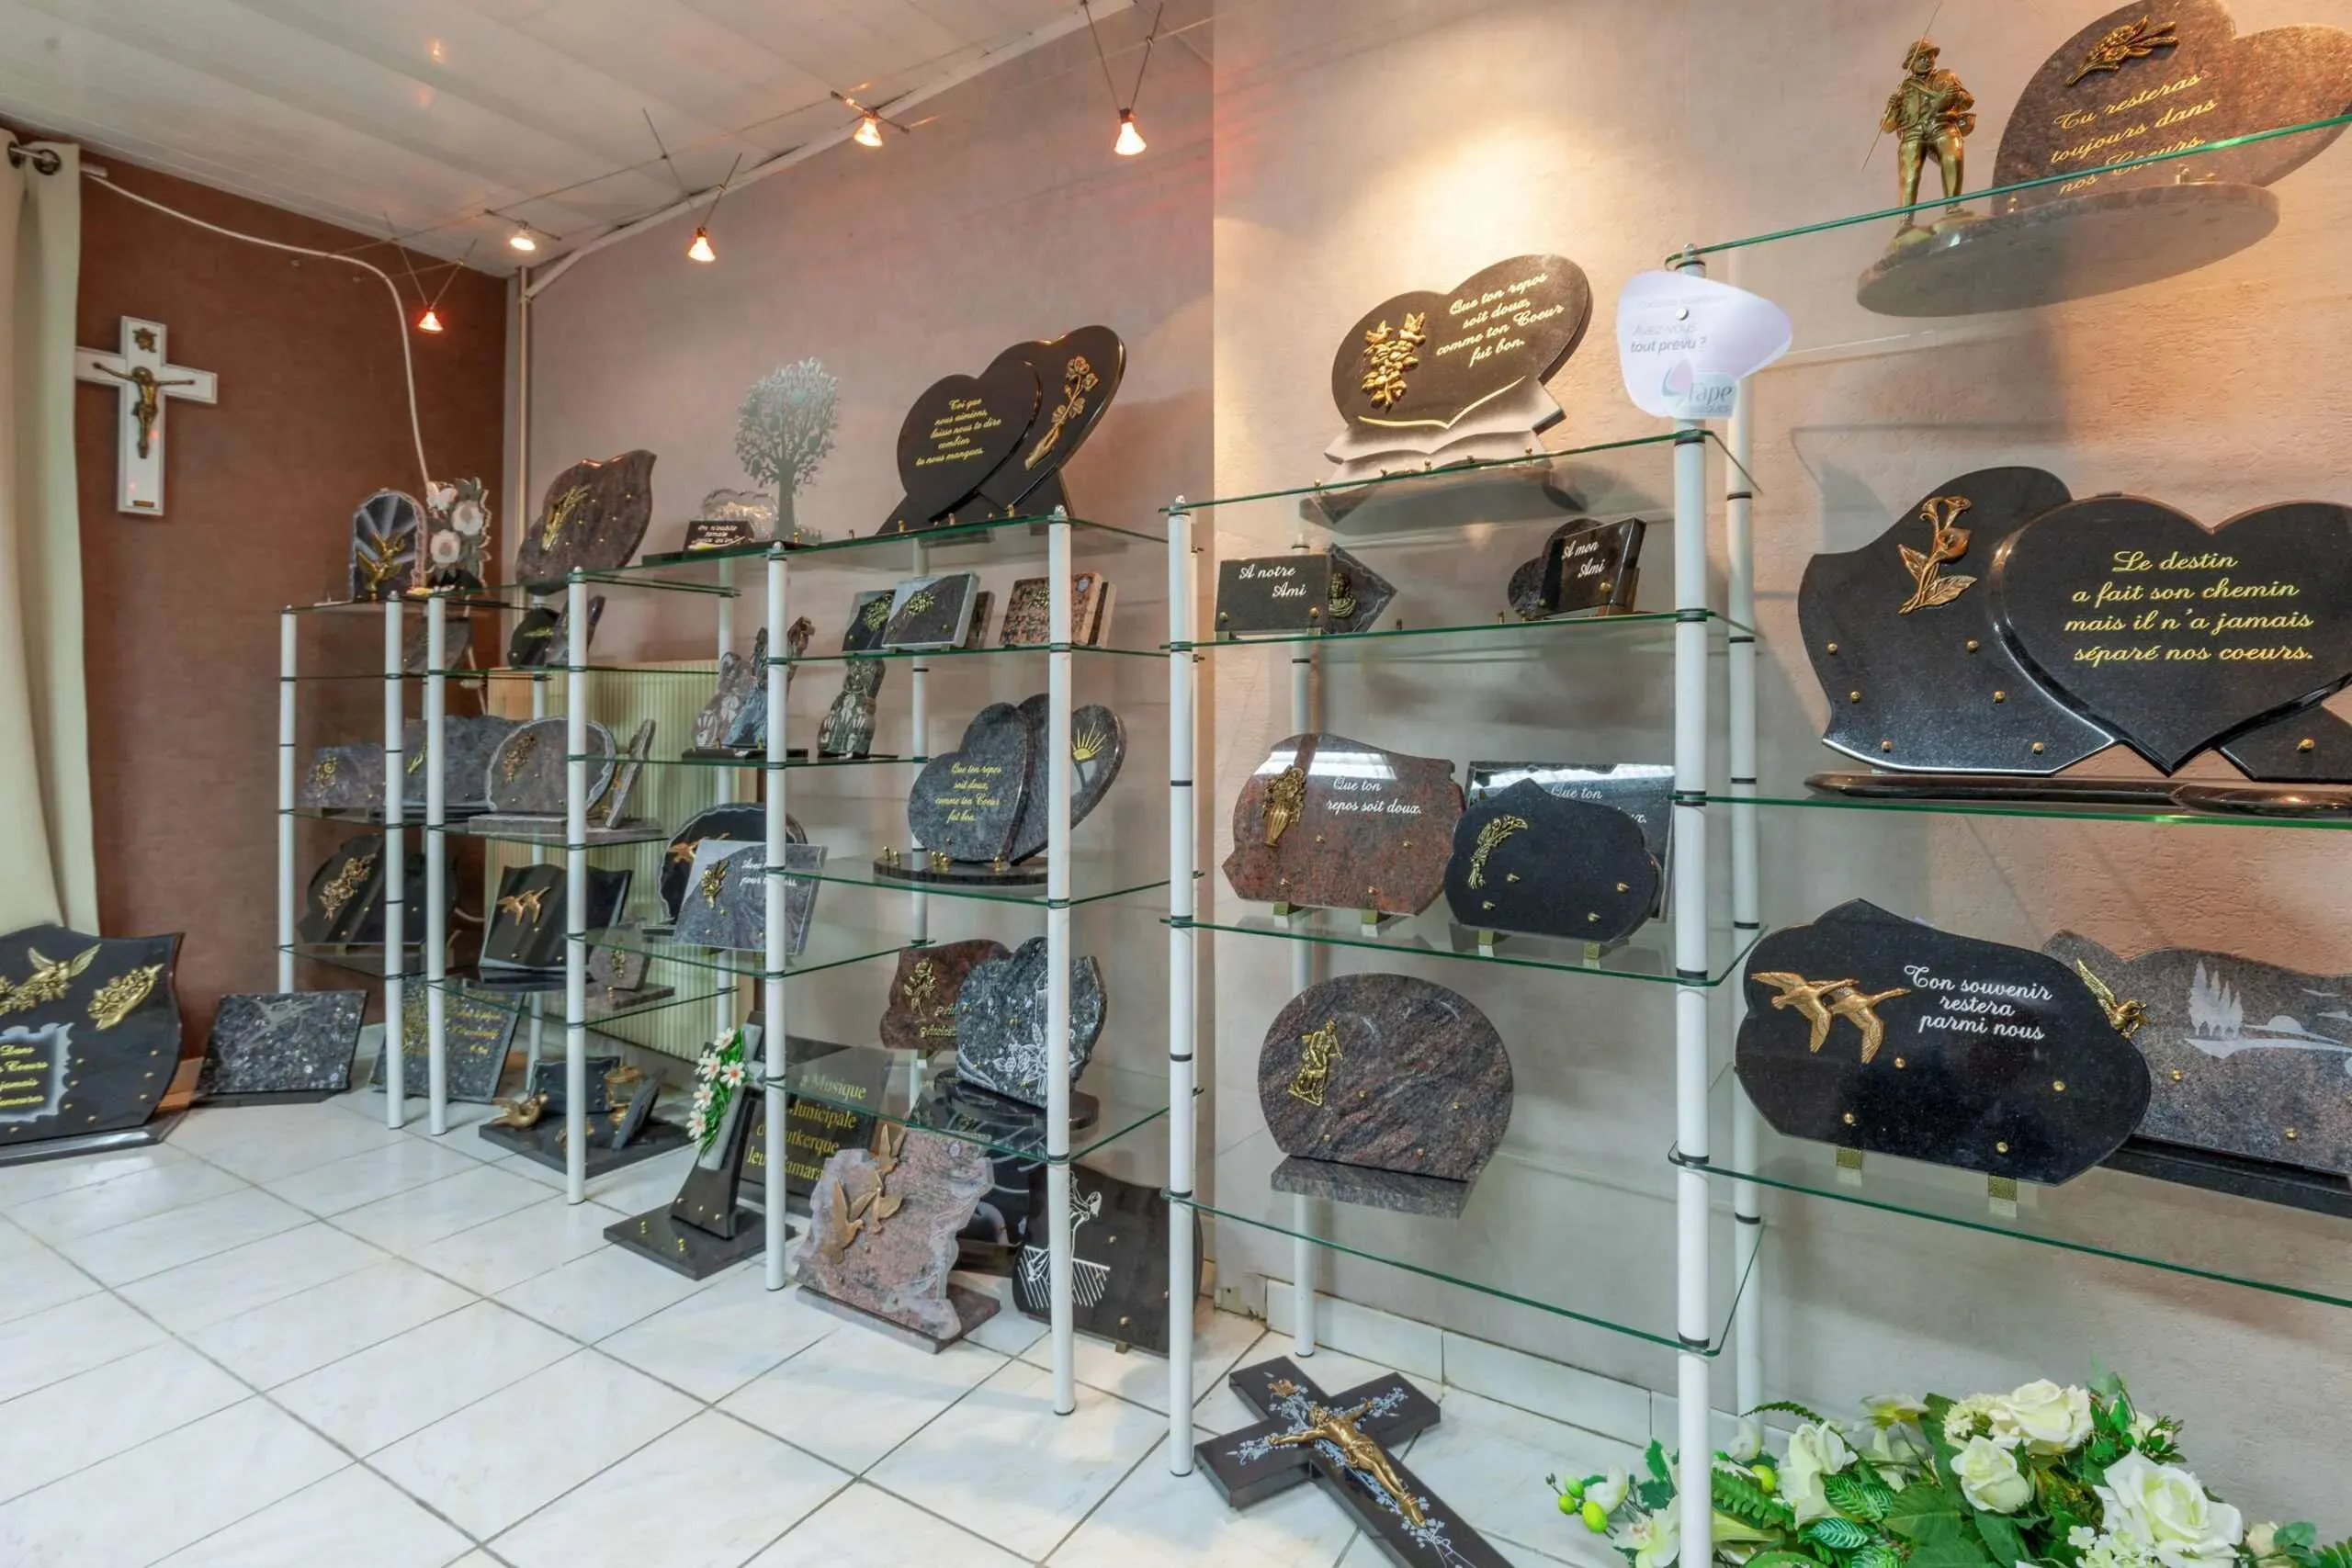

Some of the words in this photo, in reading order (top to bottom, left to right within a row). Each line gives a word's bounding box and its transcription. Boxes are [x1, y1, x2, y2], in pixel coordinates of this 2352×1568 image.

[2052, 109, 2098, 130] Tu
[2103, 74, 2202, 115] resteras
[2051, 123, 2149, 164] toujours
[2154, 99, 2218, 128] dans
[2058, 174, 2099, 196] nos
[1449, 299, 1478, 315] Que
[1480, 288, 1505, 304] ton
[1507, 272, 1549, 295] repos
[1462, 310, 1489, 330] soit
[1436, 333, 1484, 356] comme
[1486, 324, 1510, 338] ton
[1630, 341, 1656, 353] tout
[1468, 345, 1493, 368] fut
[1495, 337, 1525, 355] bon.
[1574, 541, 1600, 557] mon
[1257, 566, 1296, 578] notre
[1577, 558, 1606, 579] Ami
[2111, 550, 2154, 573] Le
[2159, 550, 2239, 570] destin
[1272, 581, 1307, 598] Ami
[2071, 590, 2091, 604] a
[2094, 581, 2144, 609] fait
[2150, 586, 2196, 601] son
[2201, 577, 2301, 599] chemin
[2064, 615, 2126, 632] mais
[2132, 609, 2159, 631] il
[2210, 611, 2314, 636] jamais
[2074, 645, 2162, 669] séparé
[2165, 648, 2212, 661] nos
[2219, 646, 2313, 660] coeurs.
[1333, 776, 1359, 790] Que
[1362, 780, 1383, 792] ton
[1550, 783, 1577, 799] Que
[1580, 787, 1603, 799] ton
[1326, 799, 1359, 816] repos
[1361, 800, 1385, 813] soit
[1904, 964, 1956, 991] Ton
[1960, 979, 2053, 1000] souvenir
[1939, 996, 2016, 1017] restera
[1918, 1015, 1988, 1034] parmi
[1993, 1022, 2045, 1041] nous
[748, 1146, 766, 1167] leu
